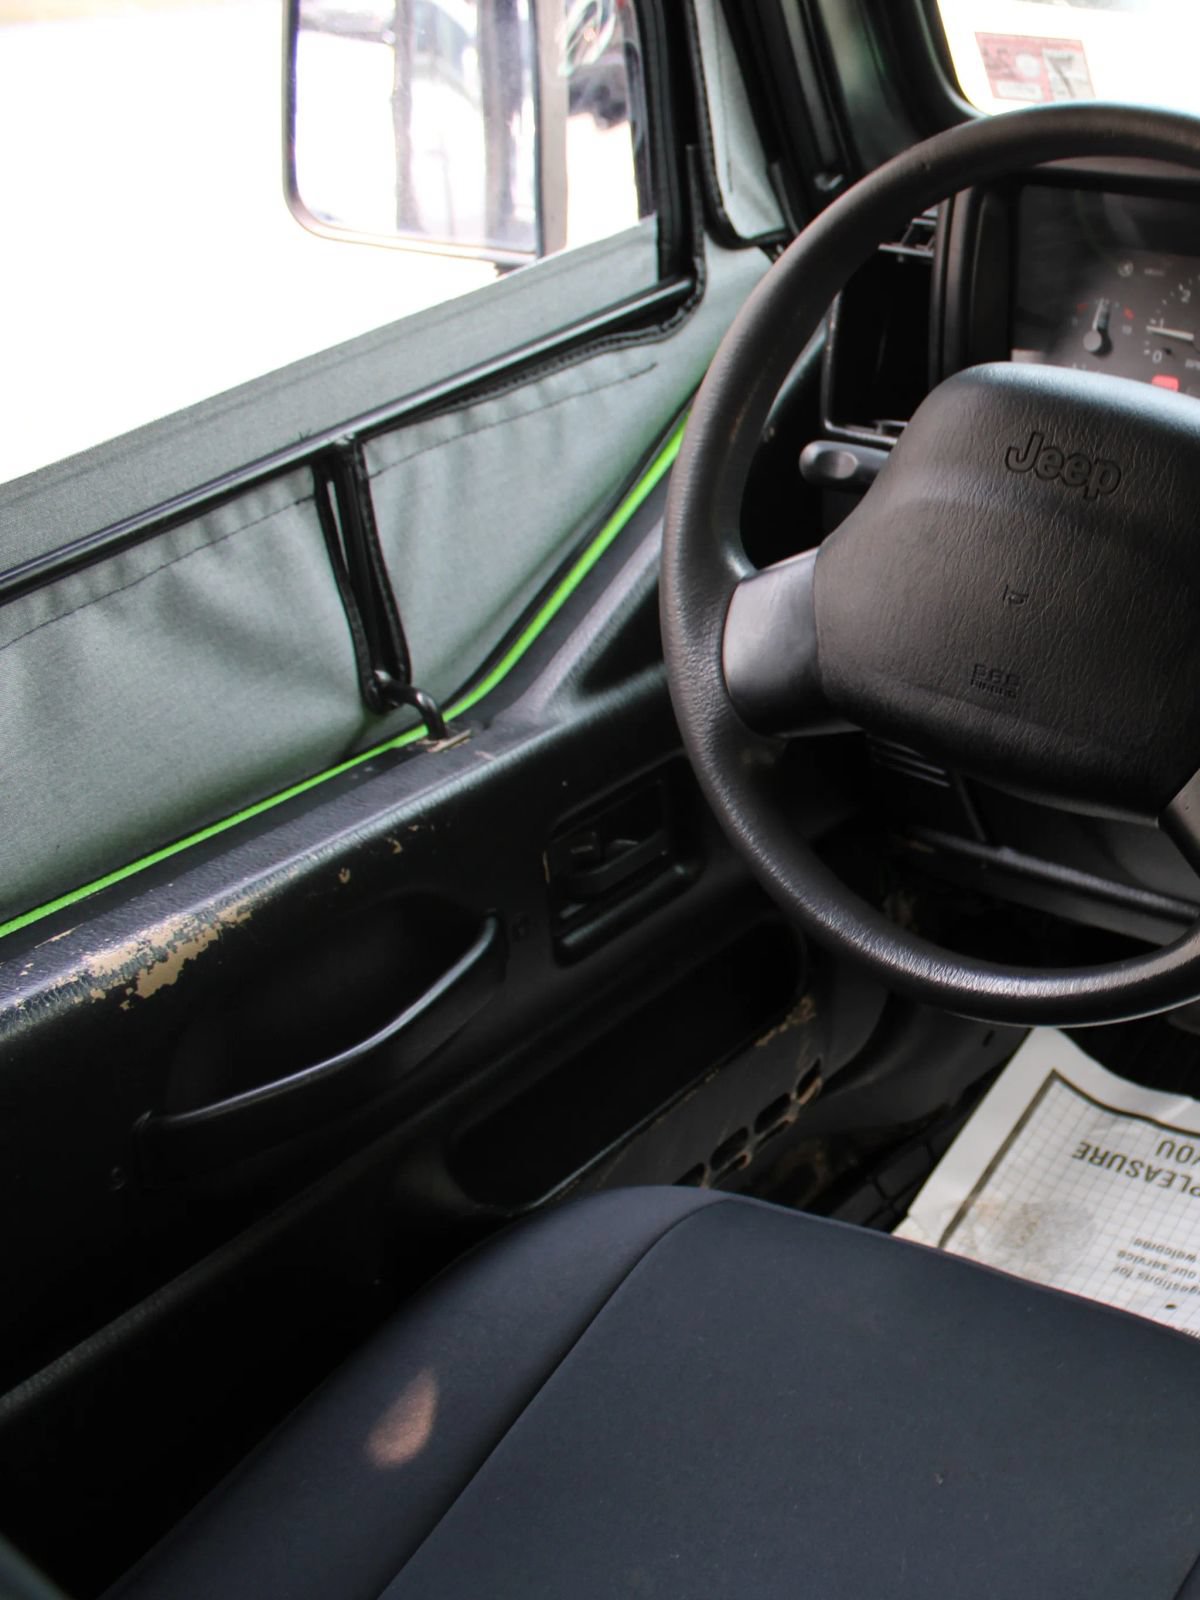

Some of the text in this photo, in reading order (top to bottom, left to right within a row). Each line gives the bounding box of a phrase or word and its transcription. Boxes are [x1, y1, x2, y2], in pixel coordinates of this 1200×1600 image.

[1180, 289, 1192, 303] 2
[1151, 350, 1163, 364] 0
[1004, 431, 1121, 501] Jeep
[1116, 1249, 1170, 1273] service
[1112, 1265, 1133, 1280] for
[1172, 1266, 1198, 1279] our
